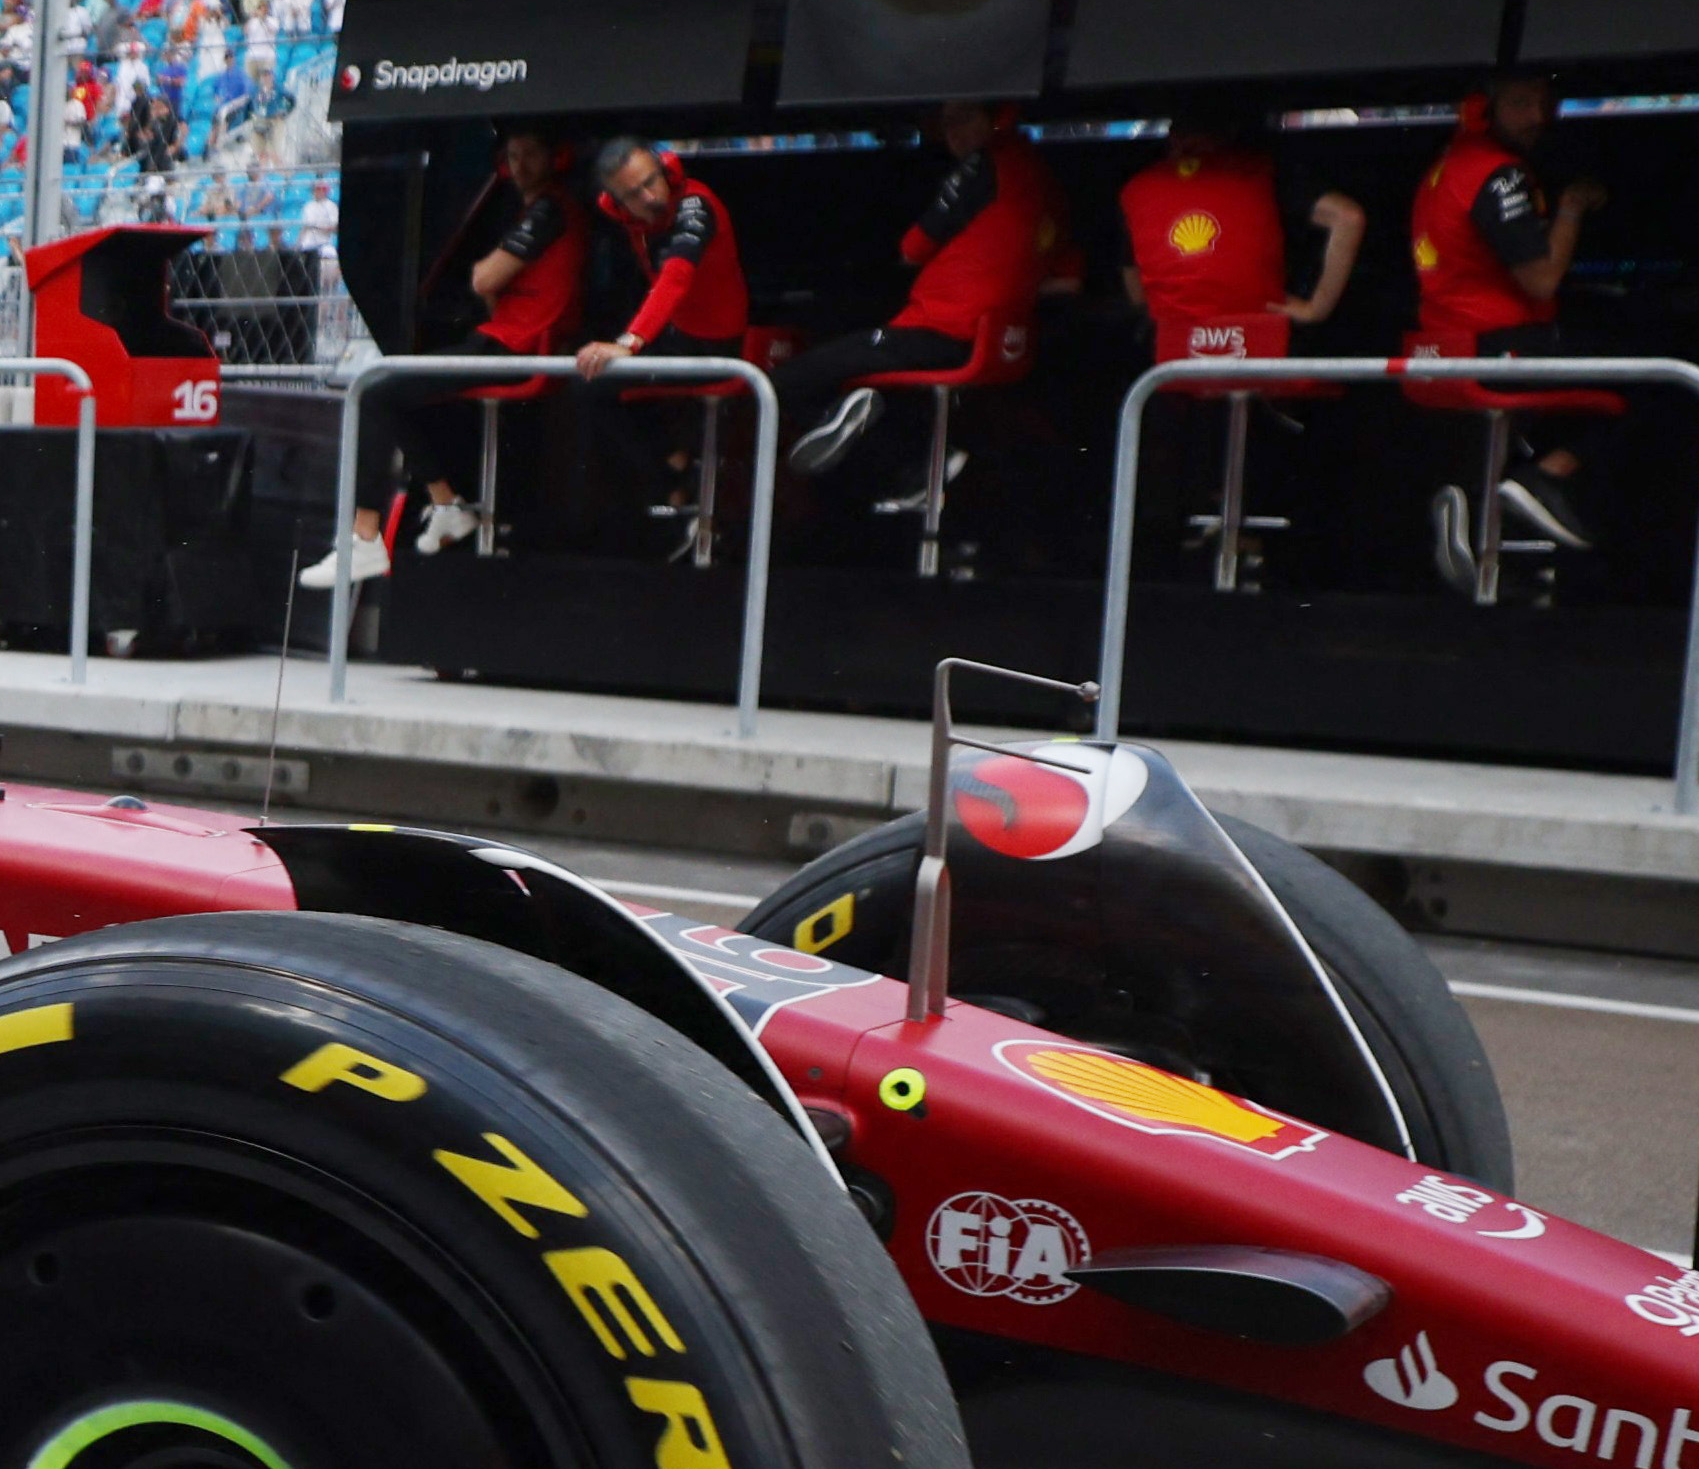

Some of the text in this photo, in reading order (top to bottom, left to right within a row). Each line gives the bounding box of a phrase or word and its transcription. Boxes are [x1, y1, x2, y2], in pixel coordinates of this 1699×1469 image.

[373, 56, 528, 93] Snapdragon
[1192, 327, 1246, 349] aws
[172, 379, 218, 421] 16
[280, 1042, 428, 1103] P
[1395, 1174, 1495, 1223] aws
